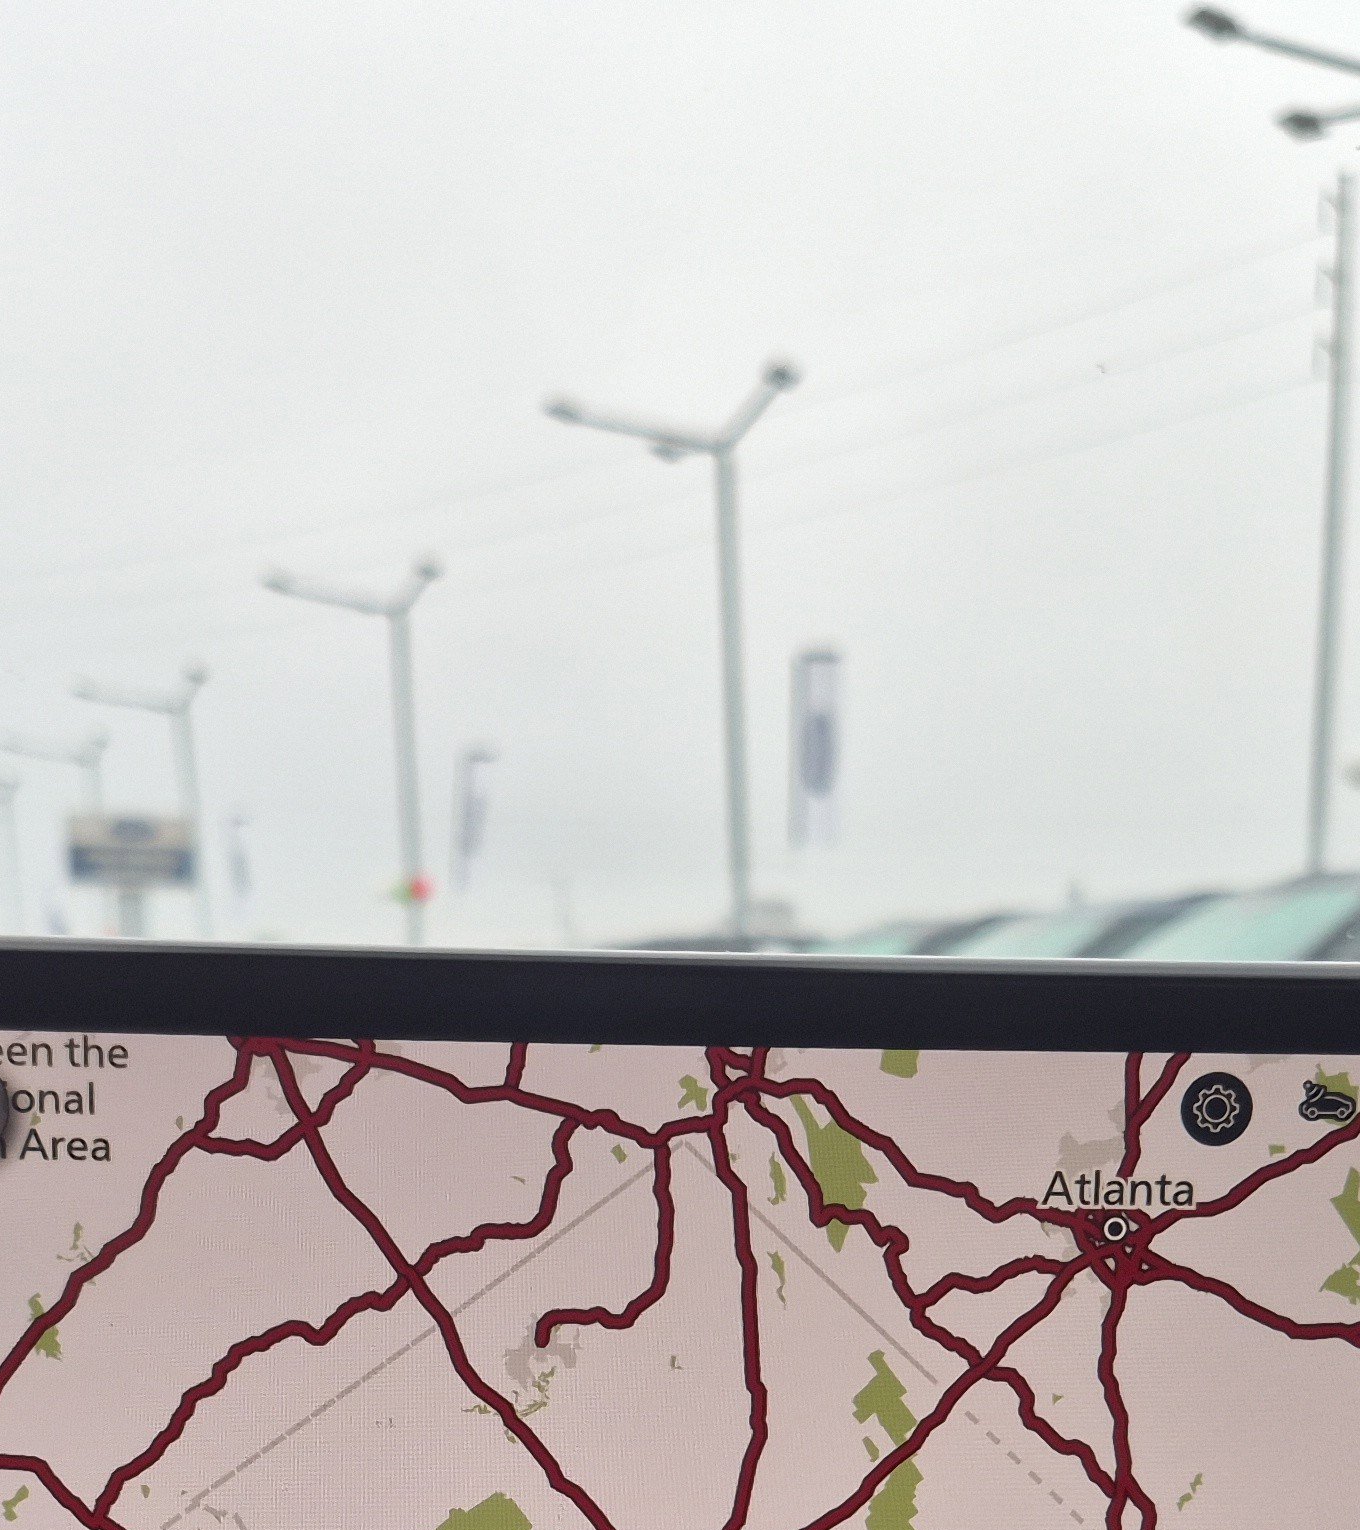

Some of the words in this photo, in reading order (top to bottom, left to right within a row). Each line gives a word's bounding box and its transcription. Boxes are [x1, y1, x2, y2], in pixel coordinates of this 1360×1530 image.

[64, 1033, 130, 1069] the
[18, 1128, 112, 1162] Area
[1041, 1170, 1196, 1209] Atlanta
